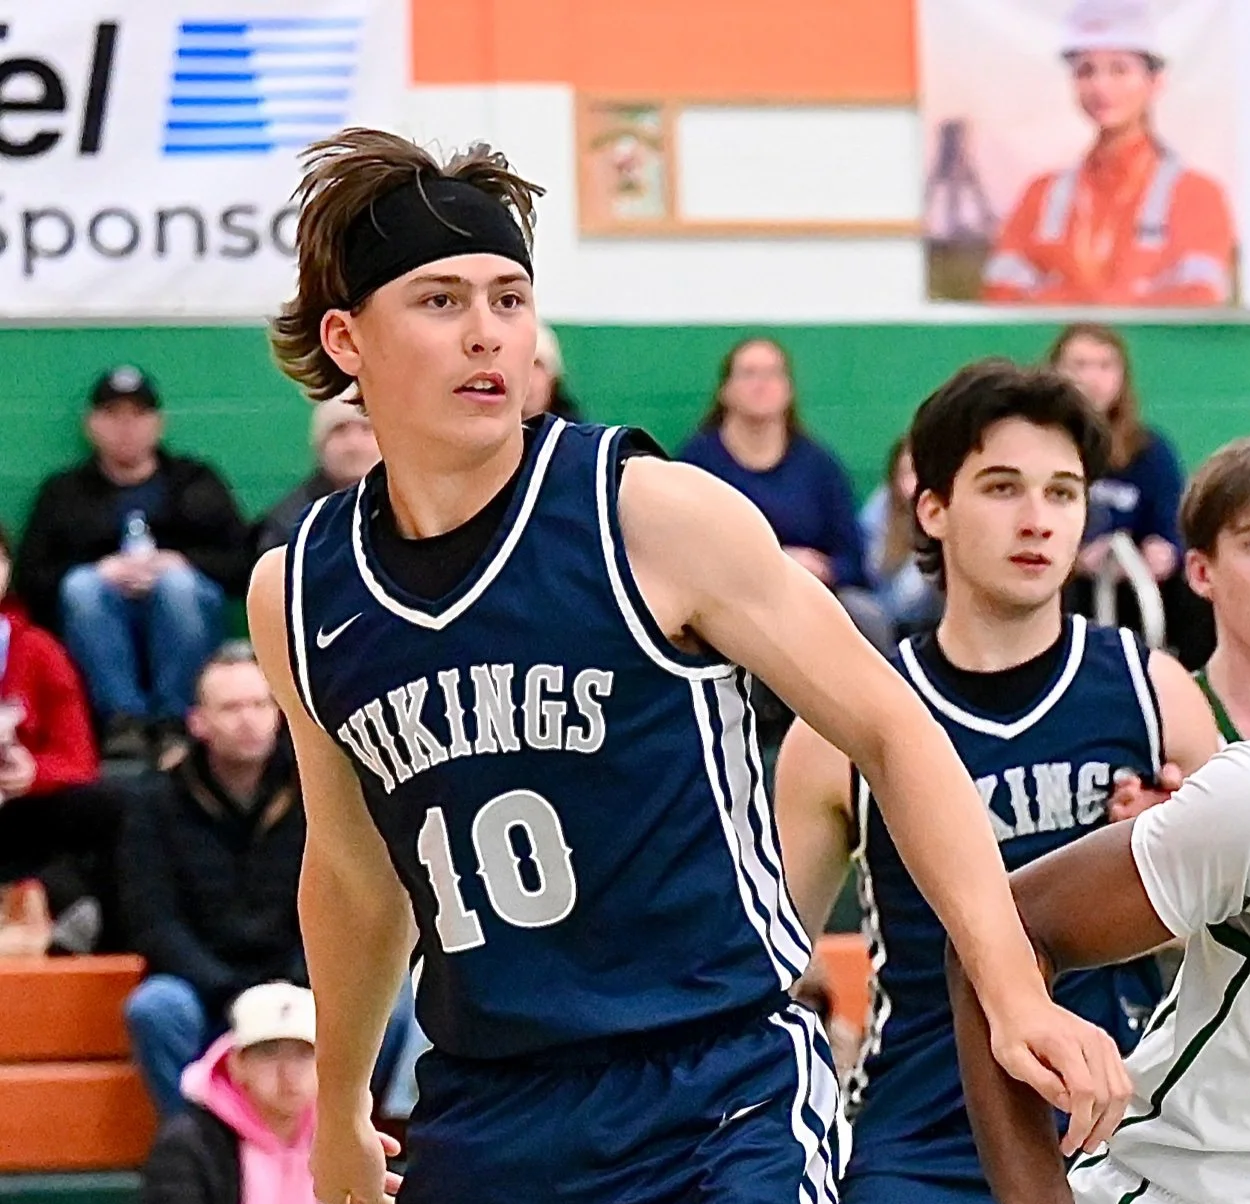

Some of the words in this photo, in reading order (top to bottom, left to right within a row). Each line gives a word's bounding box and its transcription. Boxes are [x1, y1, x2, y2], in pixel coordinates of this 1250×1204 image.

[0, 22, 119, 157] el
[337, 662, 615, 795] VIKINGS
[417, 788, 578, 953] 10
